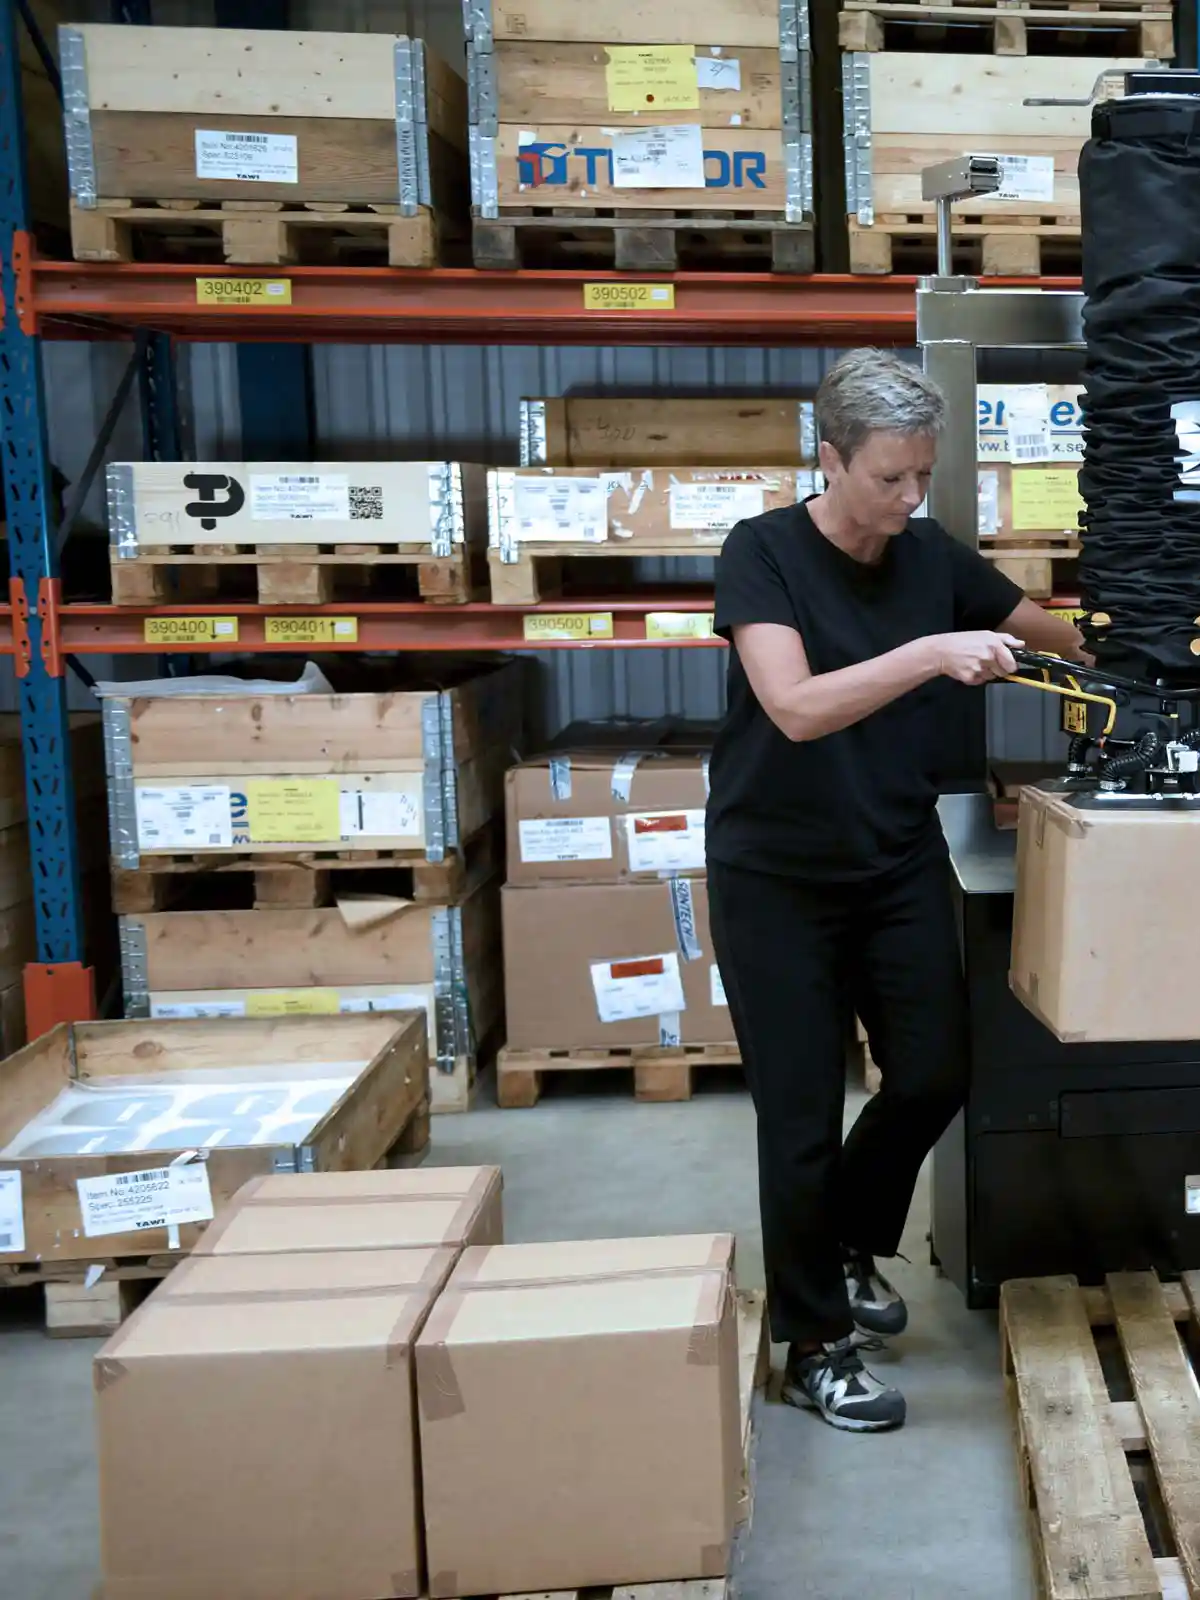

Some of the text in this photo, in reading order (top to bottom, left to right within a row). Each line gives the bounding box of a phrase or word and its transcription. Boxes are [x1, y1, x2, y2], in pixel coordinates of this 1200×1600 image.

[204, 281, 263, 295] 390402
[592, 286, 648, 300] 390502
[150, 620, 207, 634] 390400
[270, 620, 326, 634] 390401
[529, 617, 584, 630] 390500
[679, 882, 694, 937] SONTECH
[136, 1218, 165, 1228] TAWI
